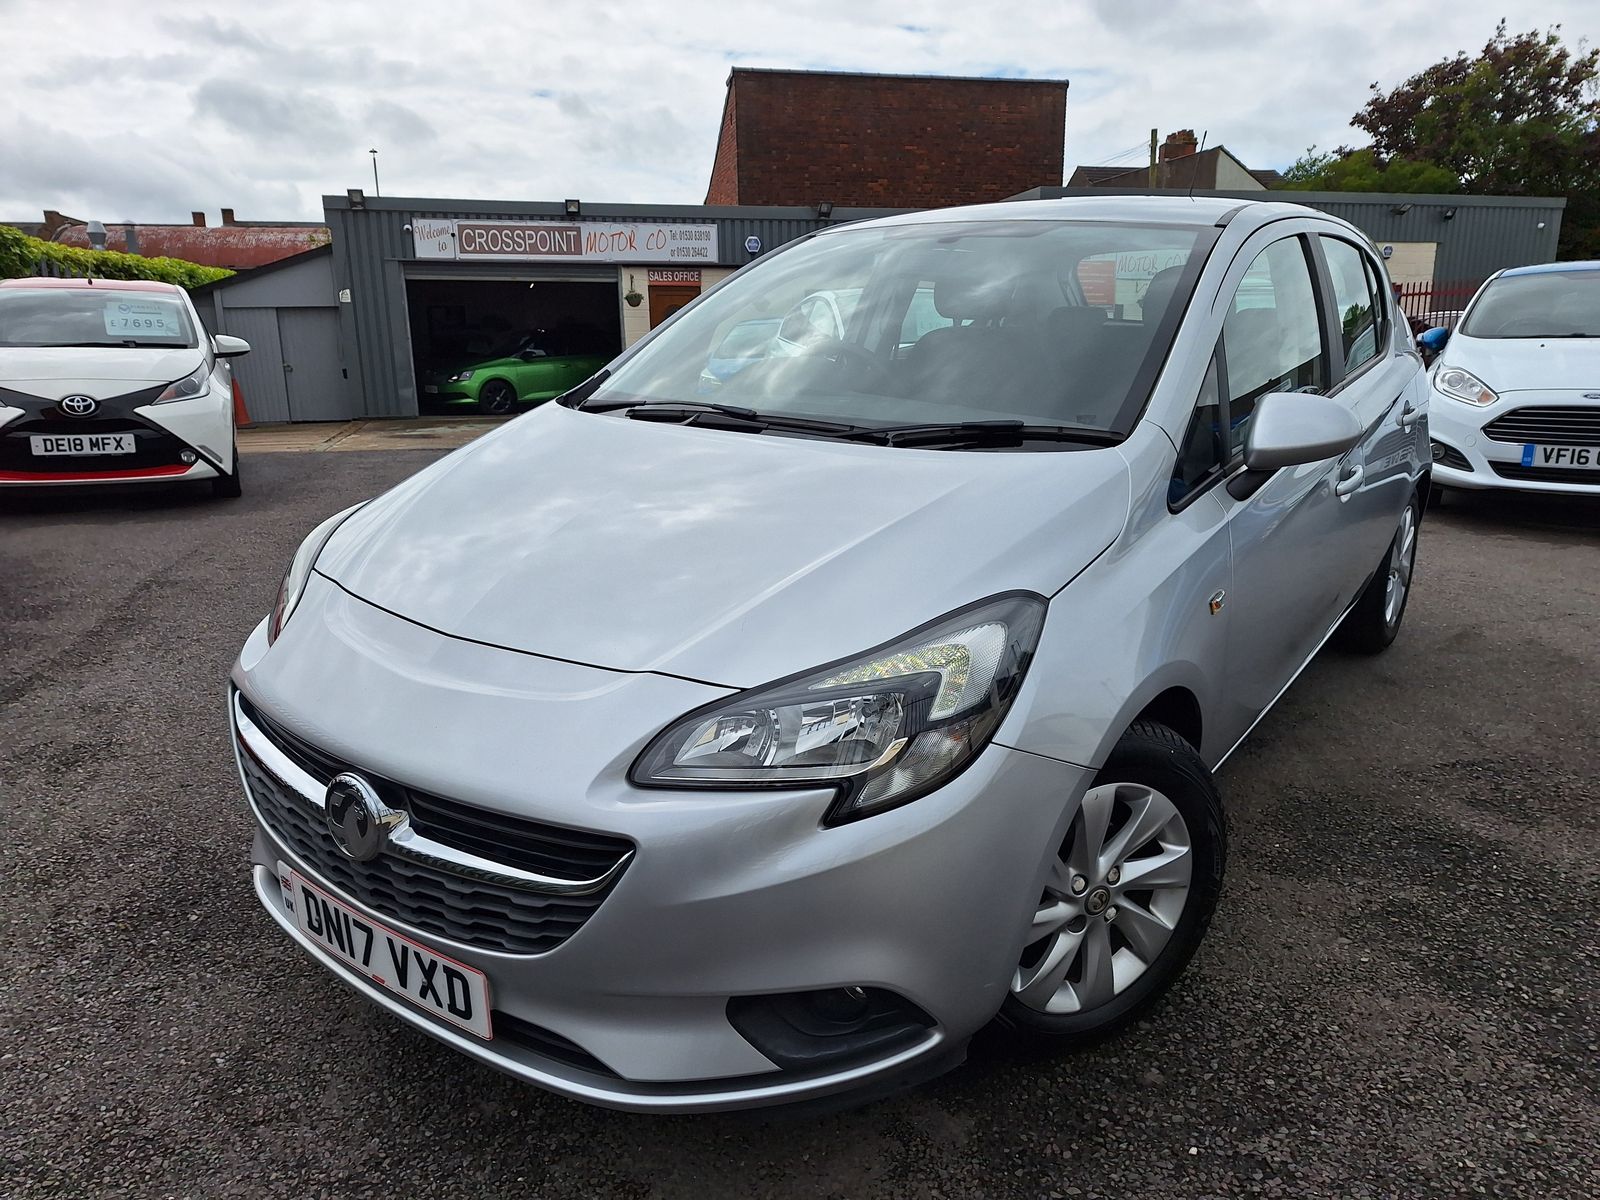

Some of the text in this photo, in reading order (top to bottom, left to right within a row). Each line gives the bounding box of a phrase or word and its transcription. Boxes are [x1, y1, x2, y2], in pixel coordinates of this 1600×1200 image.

[414, 223, 450, 241] Welcome
[679, 230, 693, 241] 01530
[438, 240, 447, 252] to
[461, 228, 666, 255] CROSSPOINT MOTOR CO
[670, 248, 676, 257] or
[677, 246, 690, 257] 01530
[1117, 254, 1158, 273] MOTOR
[649, 271, 699, 282] SALES OFFICE
[42, 436, 124, 453] DE18 MFX
[1542, 447, 1590, 465] VF16
[284, 896, 296, 914] UK
[301, 886, 473, 1021] DN17 VXD
